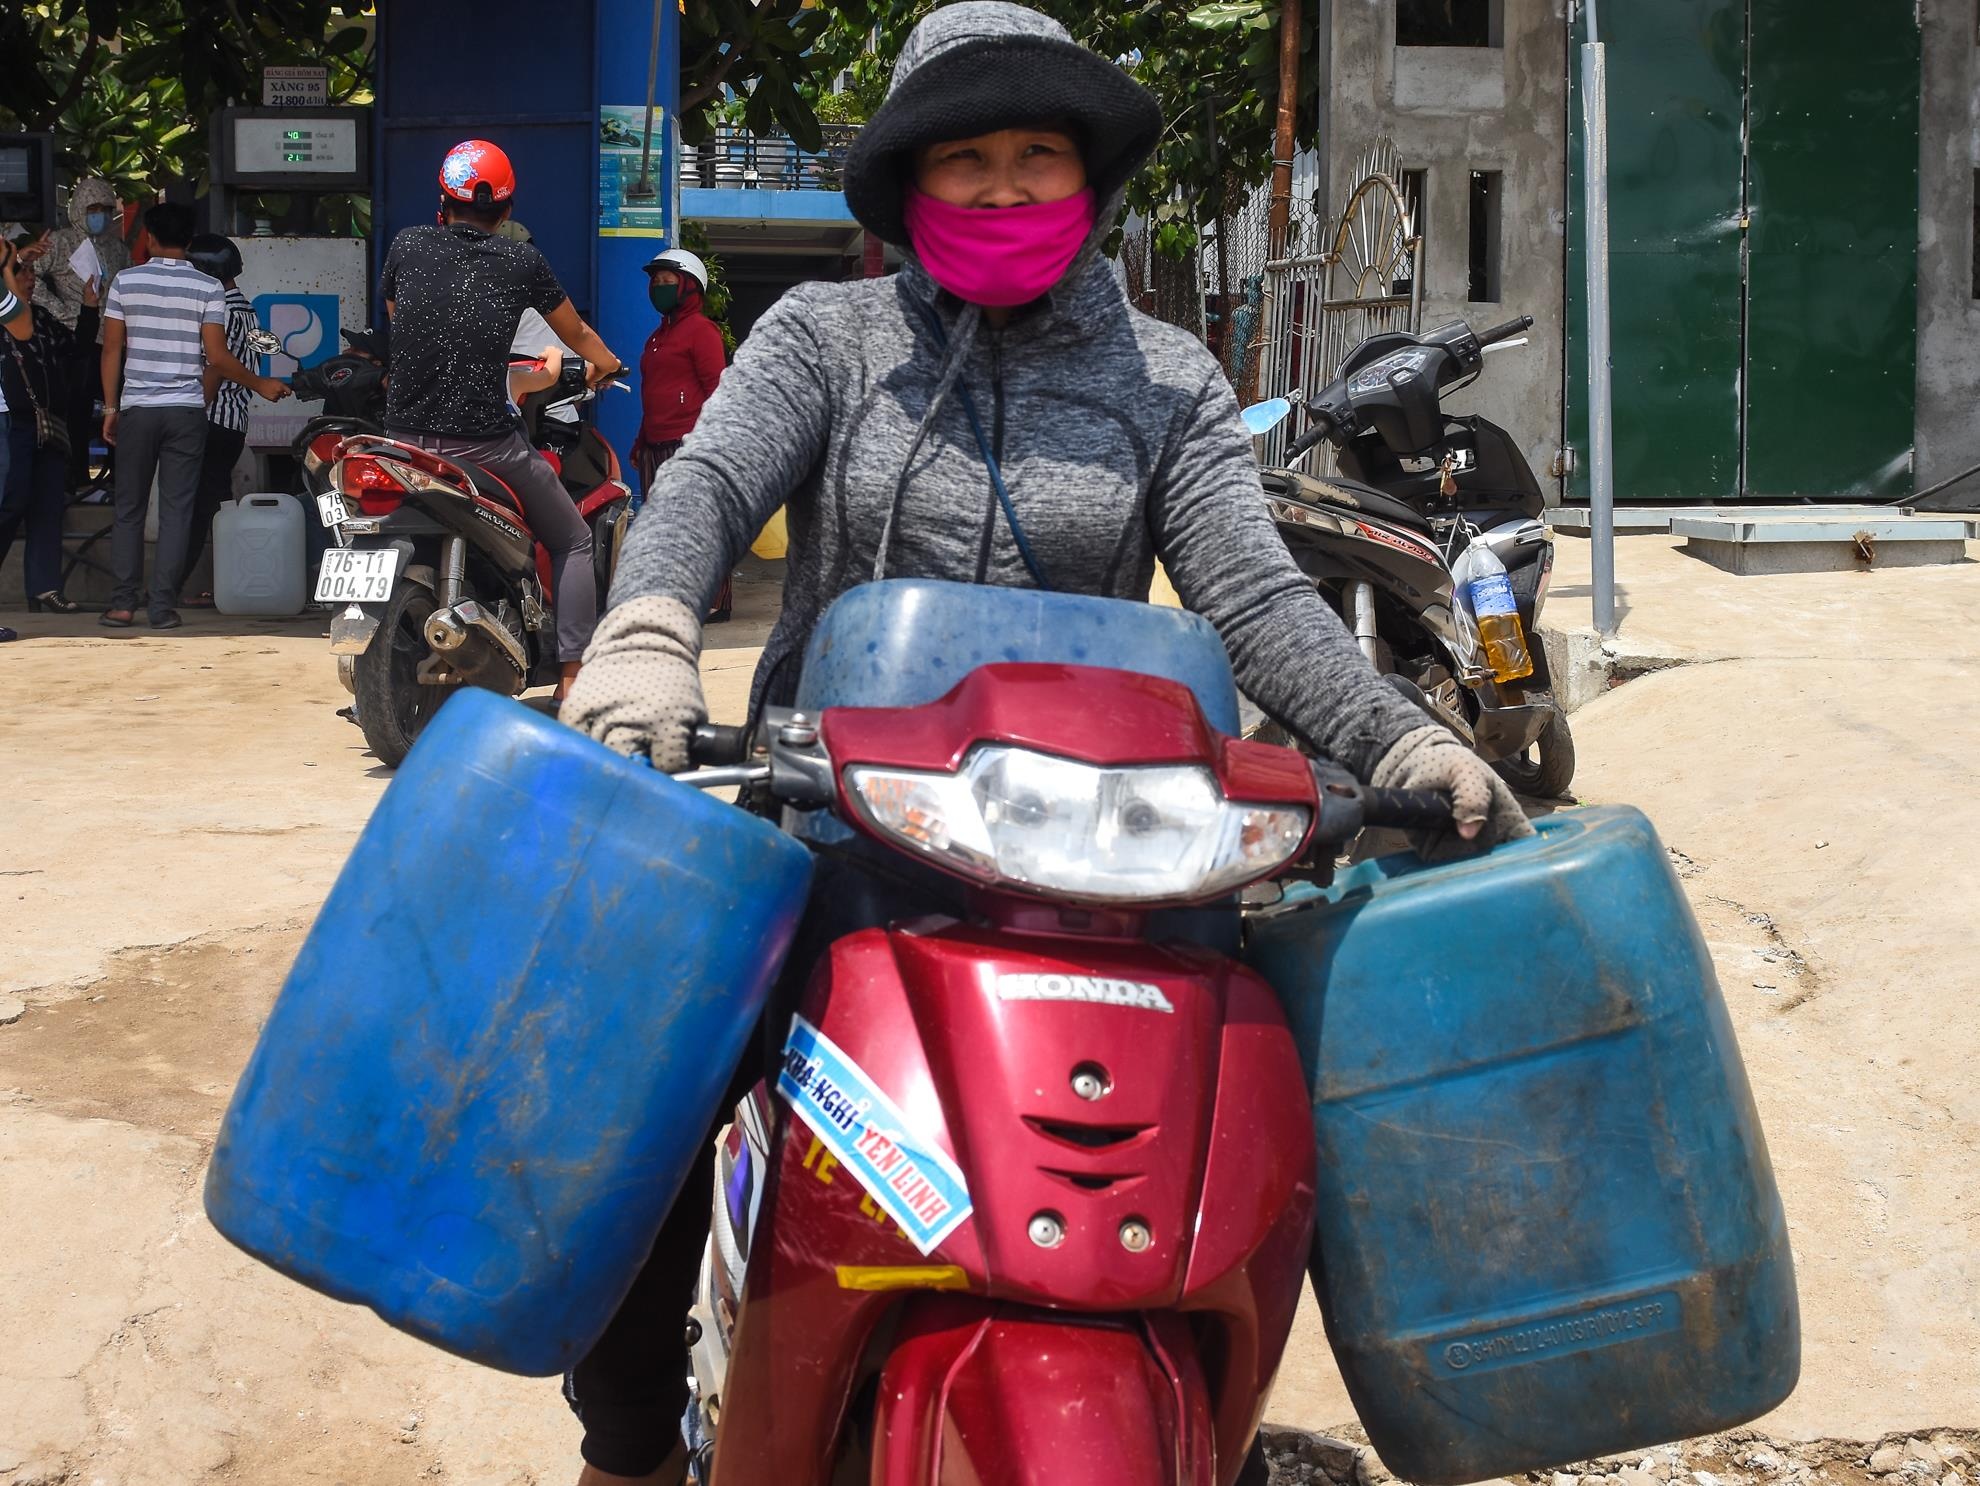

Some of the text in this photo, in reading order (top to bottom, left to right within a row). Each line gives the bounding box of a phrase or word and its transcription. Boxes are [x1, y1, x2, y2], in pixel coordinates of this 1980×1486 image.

[271, 81, 320, 91] XĂNG 95
[334, 552, 385, 573] 76-T1
[320, 576, 388, 598] 004.79
[998, 974, 1174, 1014] HONDA
[891, 1165, 947, 1224] LINH
